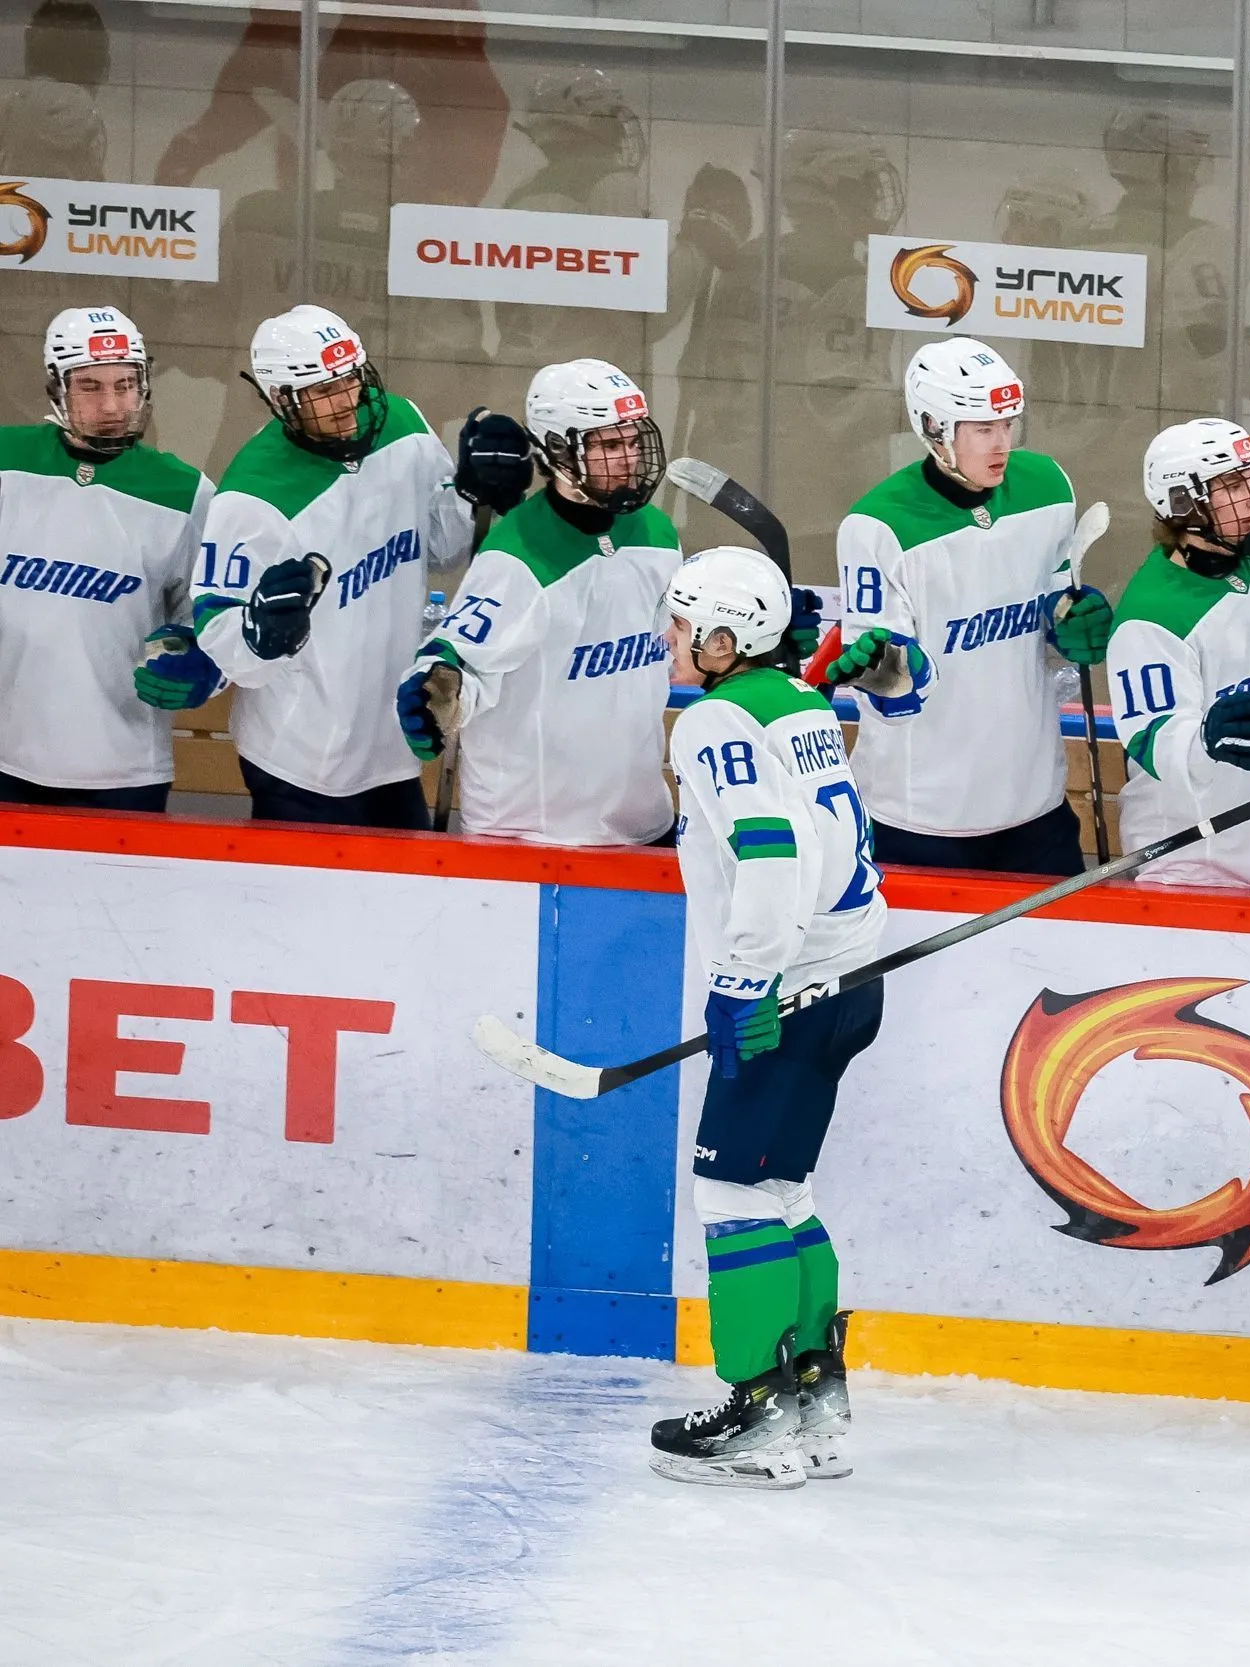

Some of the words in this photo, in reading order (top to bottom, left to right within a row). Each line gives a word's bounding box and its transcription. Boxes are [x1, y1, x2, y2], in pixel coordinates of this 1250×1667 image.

[68, 203, 196, 233] УГМК
[67, 232, 197, 261] UMMC
[416, 239, 639, 276] OLIMPBET
[995, 266, 1124, 298] УГМК
[88, 312, 114, 323] 86
[994, 296, 1124, 325] UMMC
[313, 326, 341, 344] 16
[1162, 471, 1186, 480] CCM
[193, 542, 251, 590] 16
[716, 606, 748, 618] CCM
[1116, 663, 1176, 721] 10
